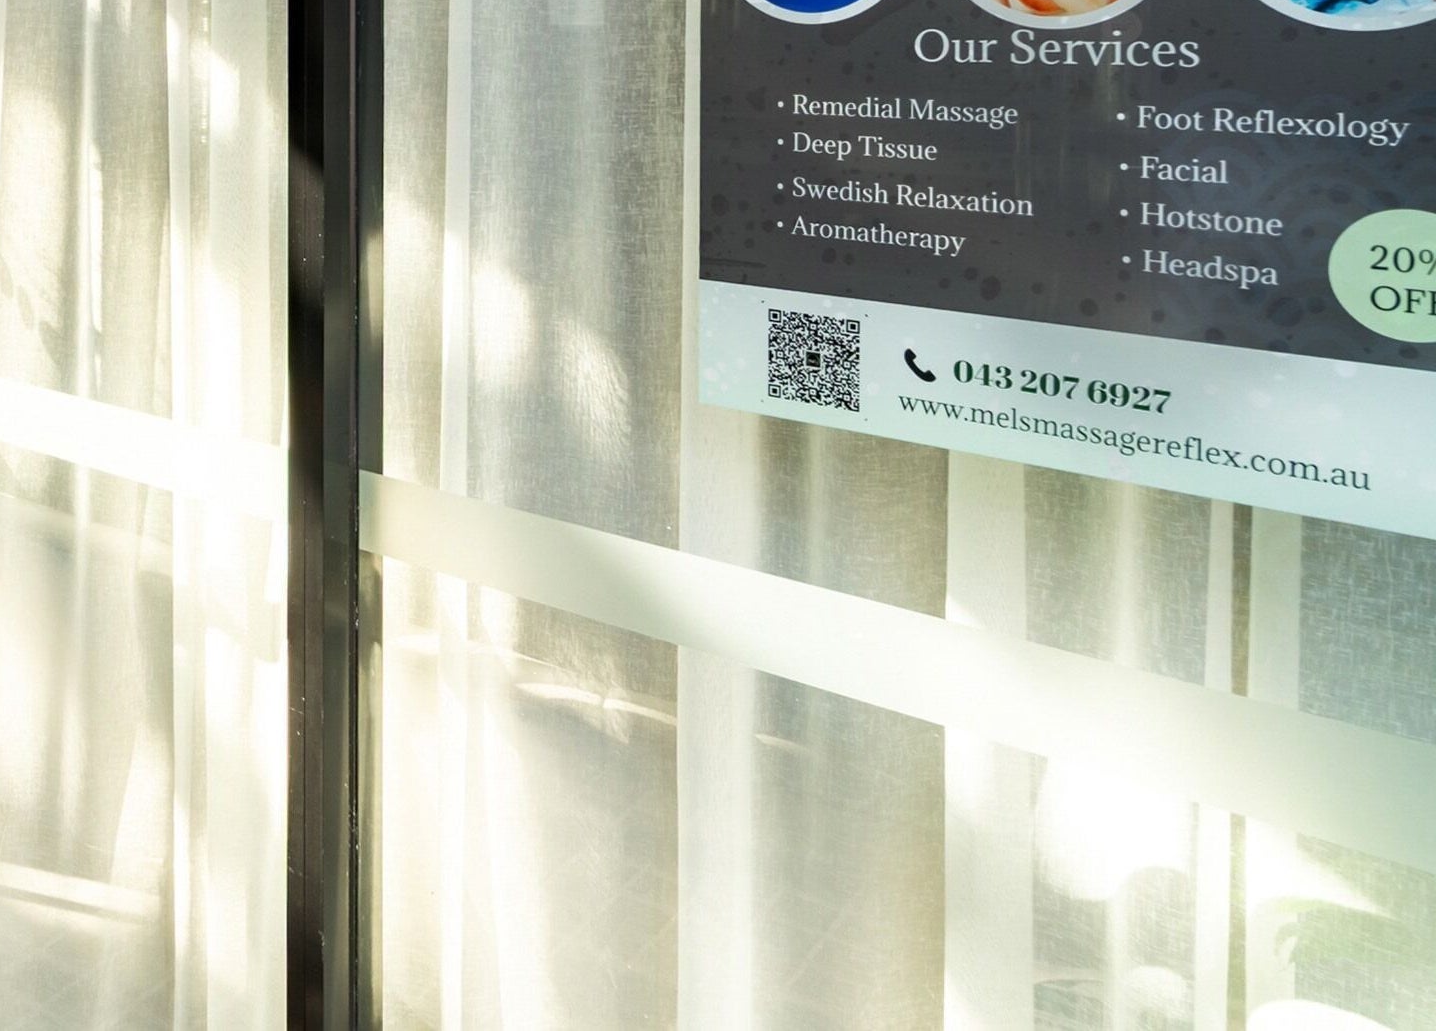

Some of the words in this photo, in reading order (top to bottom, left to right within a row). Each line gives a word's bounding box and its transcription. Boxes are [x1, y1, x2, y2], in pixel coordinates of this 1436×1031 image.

[914, 28, 997, 63] Our
[1010, 29, 1201, 68] Services
[793, 94, 901, 119] Remedial
[909, 99, 1018, 129] Massage
[1137, 105, 1204, 131] Foot
[1213, 108, 1410, 146] Reflexology
[793, 132, 852, 161] Deep
[858, 135, 937, 160] Tissue
[1140, 156, 1228, 184] Facial
[792, 177, 889, 204] Swedish
[896, 184, 1034, 216] Relaxation
[791, 216, 966, 257] Aromatherapy
[1140, 202, 1283, 236] Hotstone
[1143, 249, 1279, 290] Headspa
[1370, 244, 1436, 276] 20%
[953, 359, 1013, 391] 043
[1020, 369, 1080, 401] 207
[1087, 380, 1171, 414] 6927
[898, 394, 1372, 491] www.melsmassagereflex.com.au
